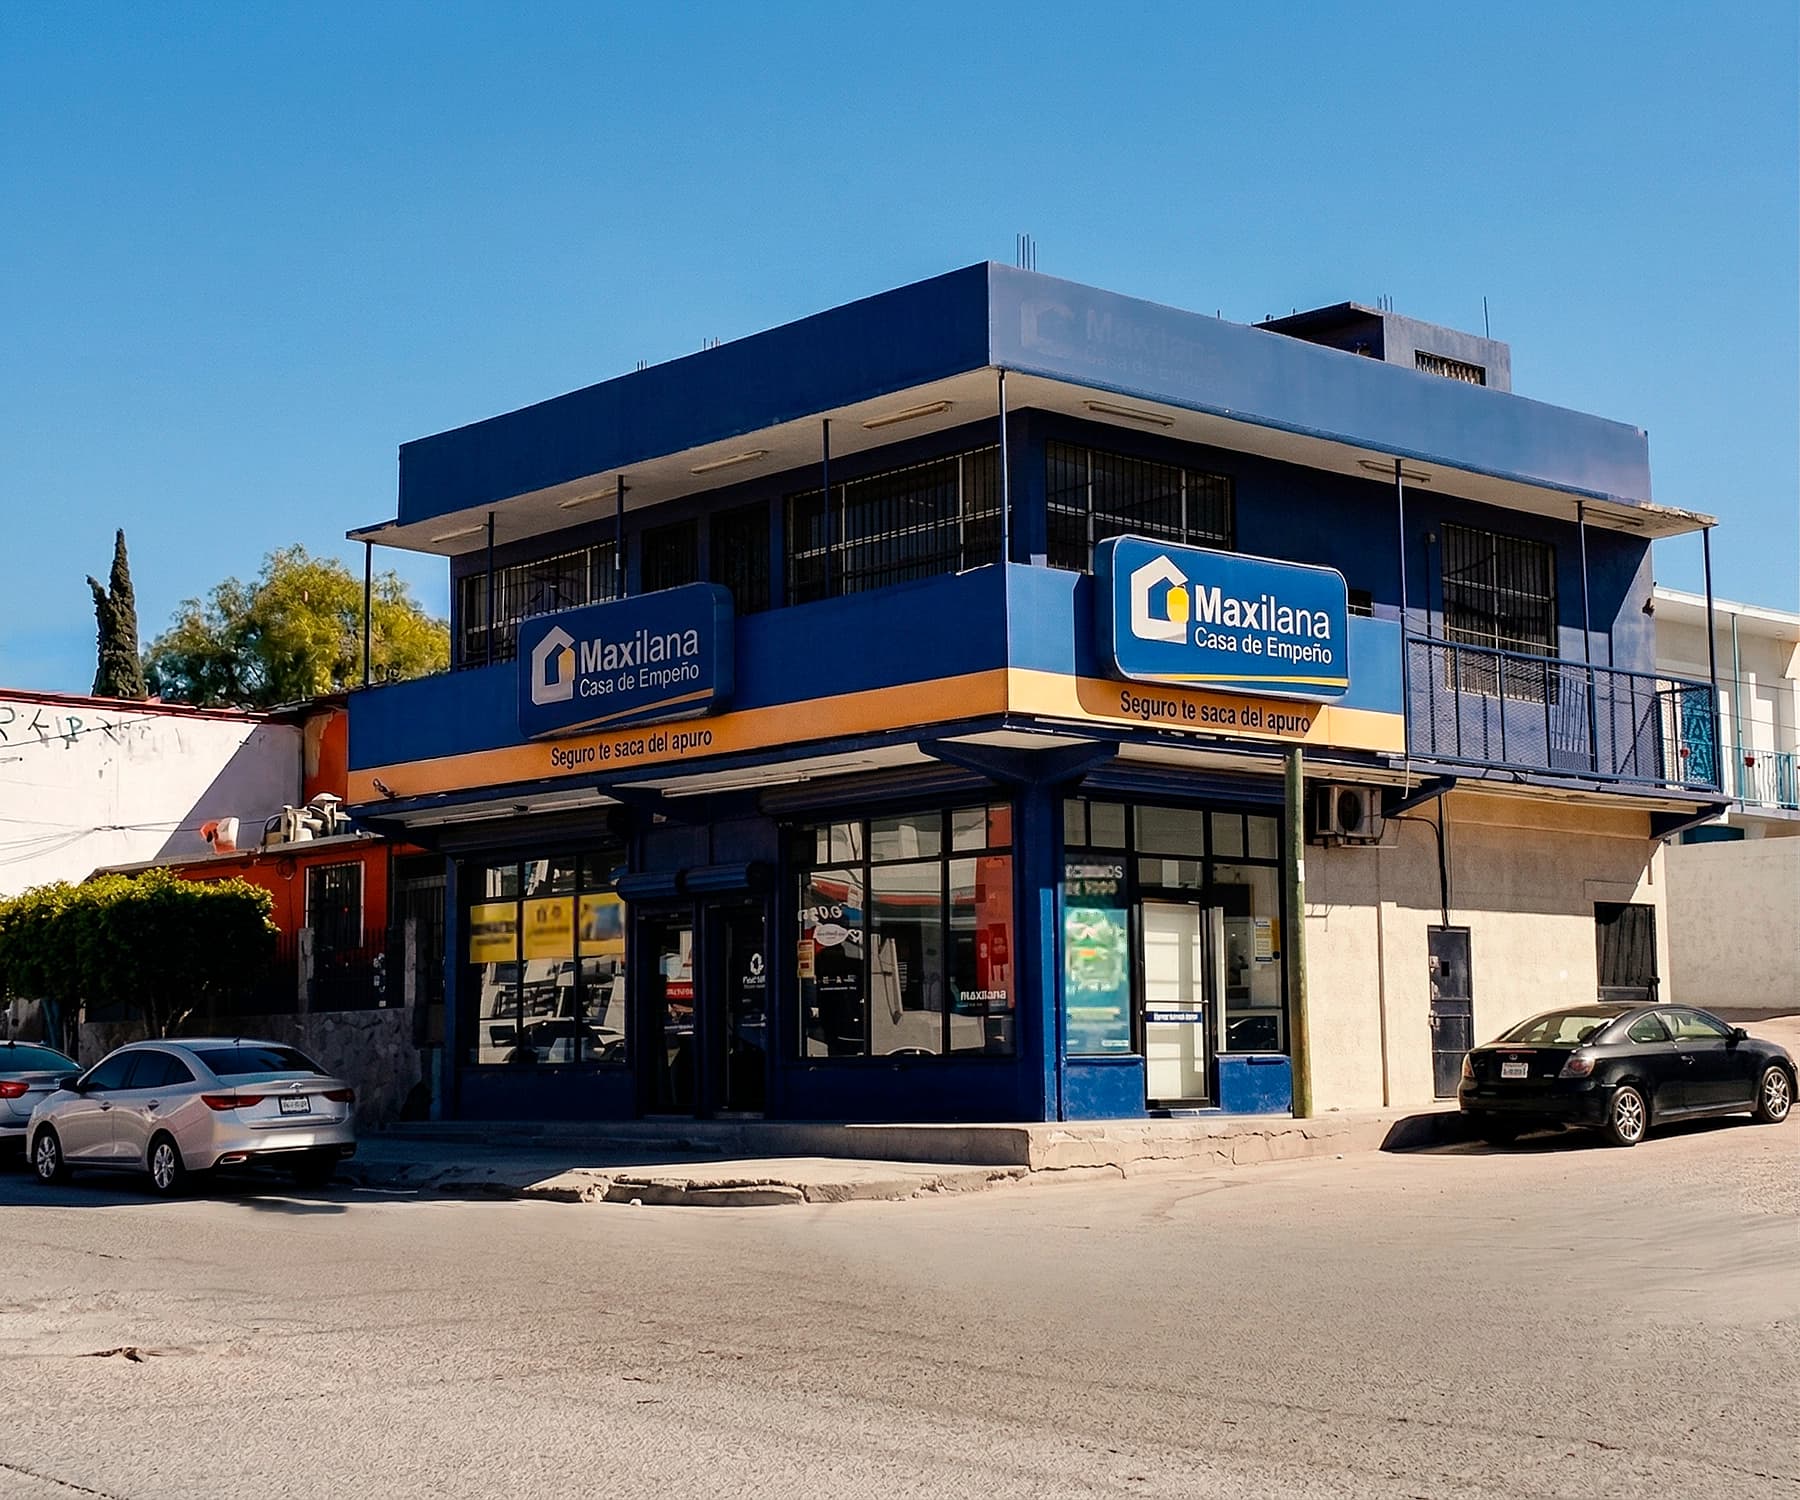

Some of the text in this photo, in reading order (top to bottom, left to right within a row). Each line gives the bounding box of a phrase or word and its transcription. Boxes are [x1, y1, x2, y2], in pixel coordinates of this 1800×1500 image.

[1195, 584, 1331, 640] Maxilana
[580, 628, 700, 676] Maxilana
[1194, 626, 1333, 665] Casa de Empeño
[579, 661, 700, 698] Casa de Empeño
[1120, 690, 1311, 736] Seguro te saca del apuro
[551, 729, 713, 770] Seguro te saca del apuro
